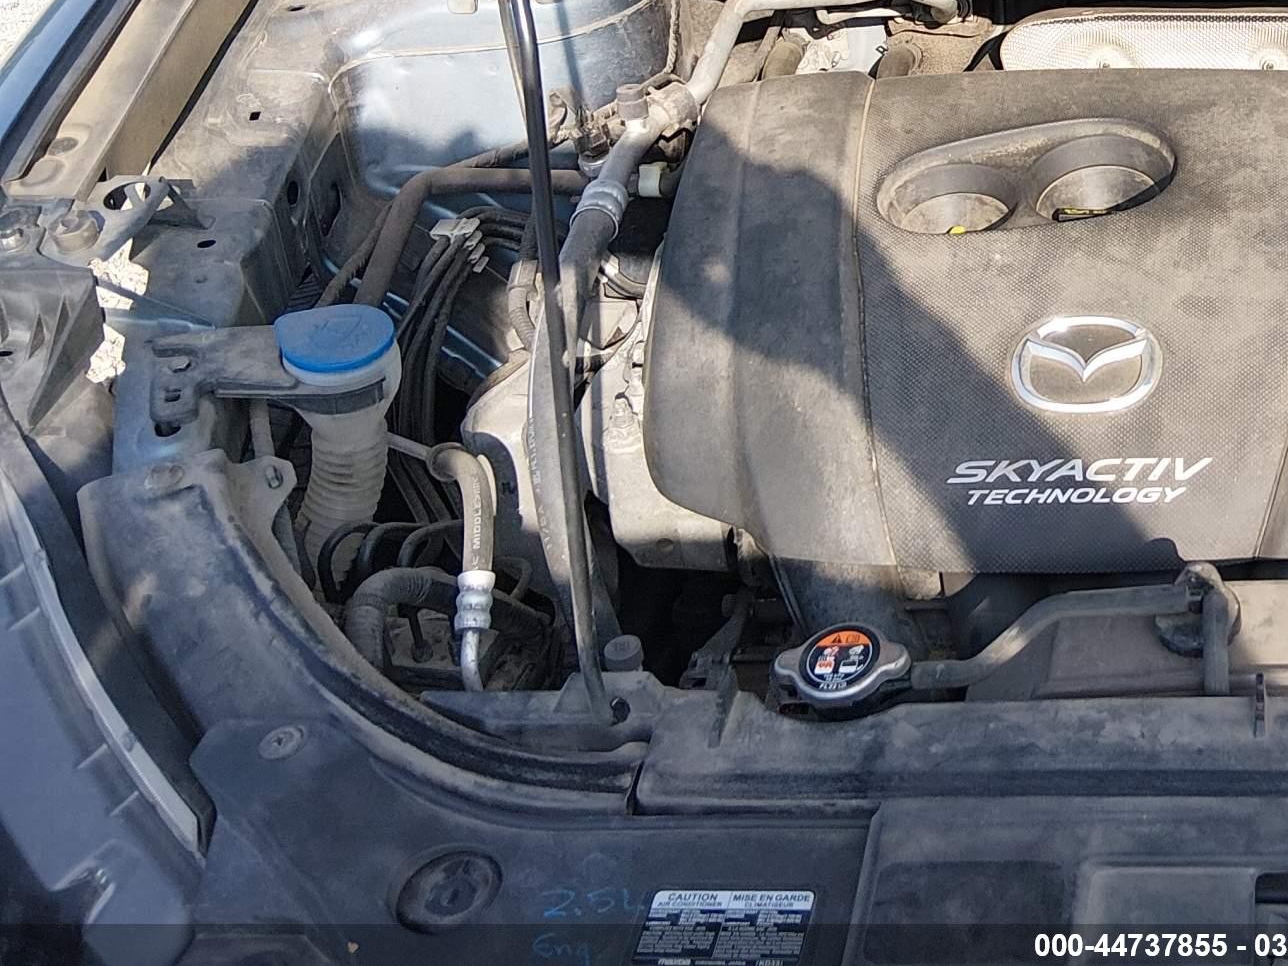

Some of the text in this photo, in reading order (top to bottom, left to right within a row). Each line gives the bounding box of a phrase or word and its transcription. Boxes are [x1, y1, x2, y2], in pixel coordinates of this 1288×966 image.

[946, 457, 1213, 483] SKYACTIV
[967, 486, 1187, 505] TECHNOLOGY
[668, 893, 718, 901] CAUTION
[774, 894, 809, 902] GARDE
